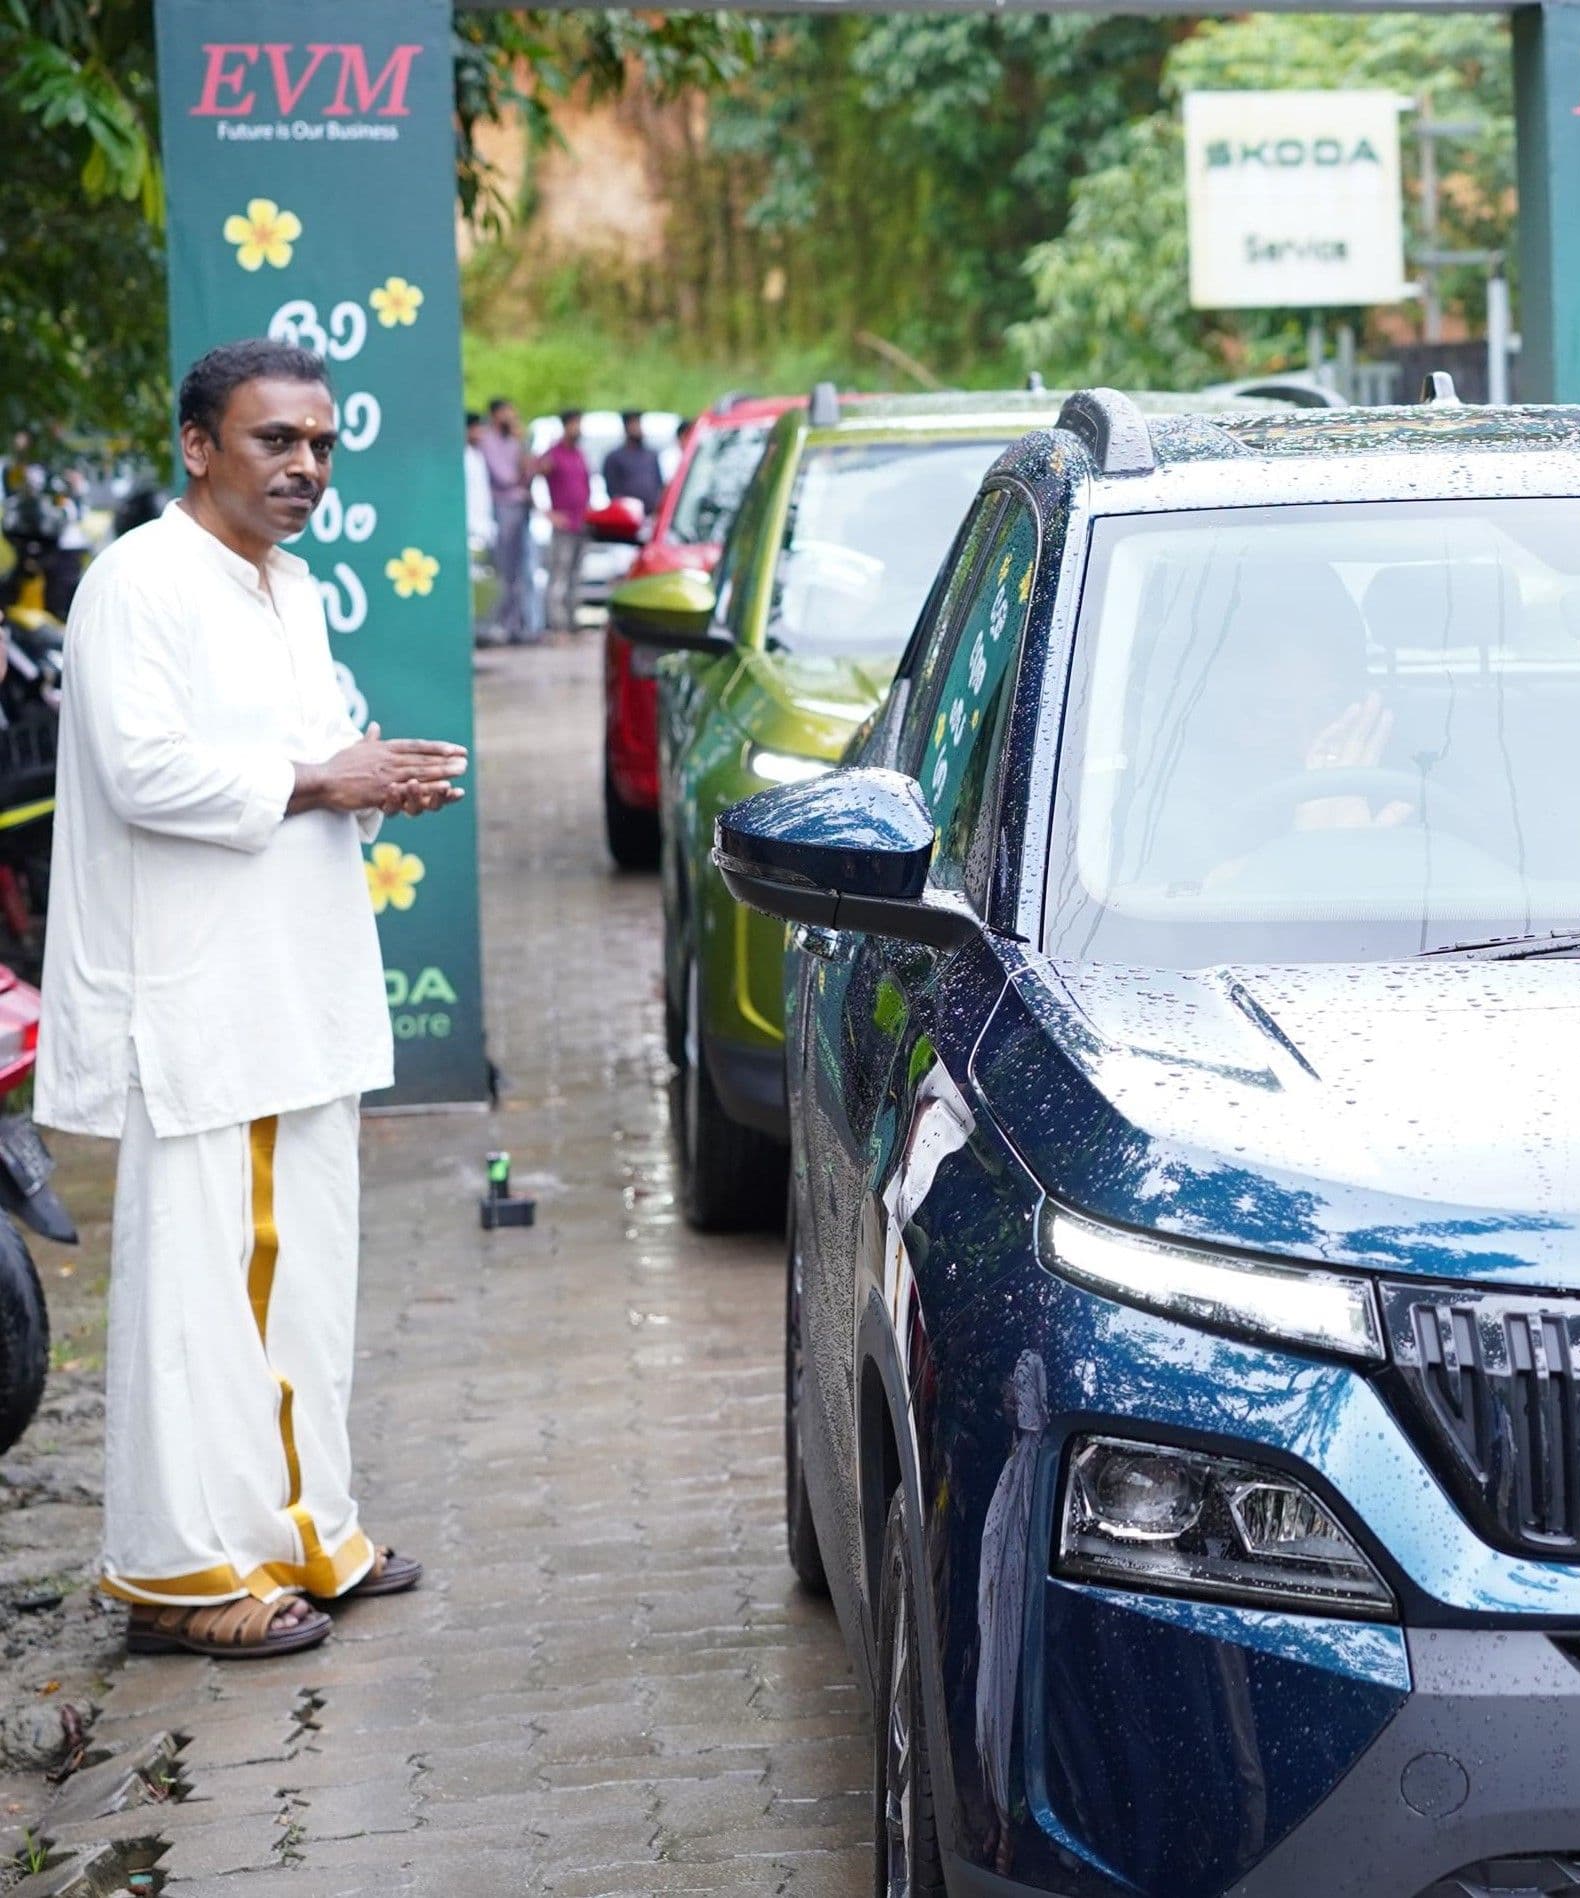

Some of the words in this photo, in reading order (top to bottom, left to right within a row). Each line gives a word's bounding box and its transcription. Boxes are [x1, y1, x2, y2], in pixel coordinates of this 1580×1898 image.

[189, 43, 424, 116] EVM
[217, 120, 274, 140] Future
[275, 121, 290, 140] is
[291, 120, 324, 140] Our
[326, 120, 399, 140] Business
[1245, 233, 1347, 264] Service
[391, 1012, 451, 1039] ore
